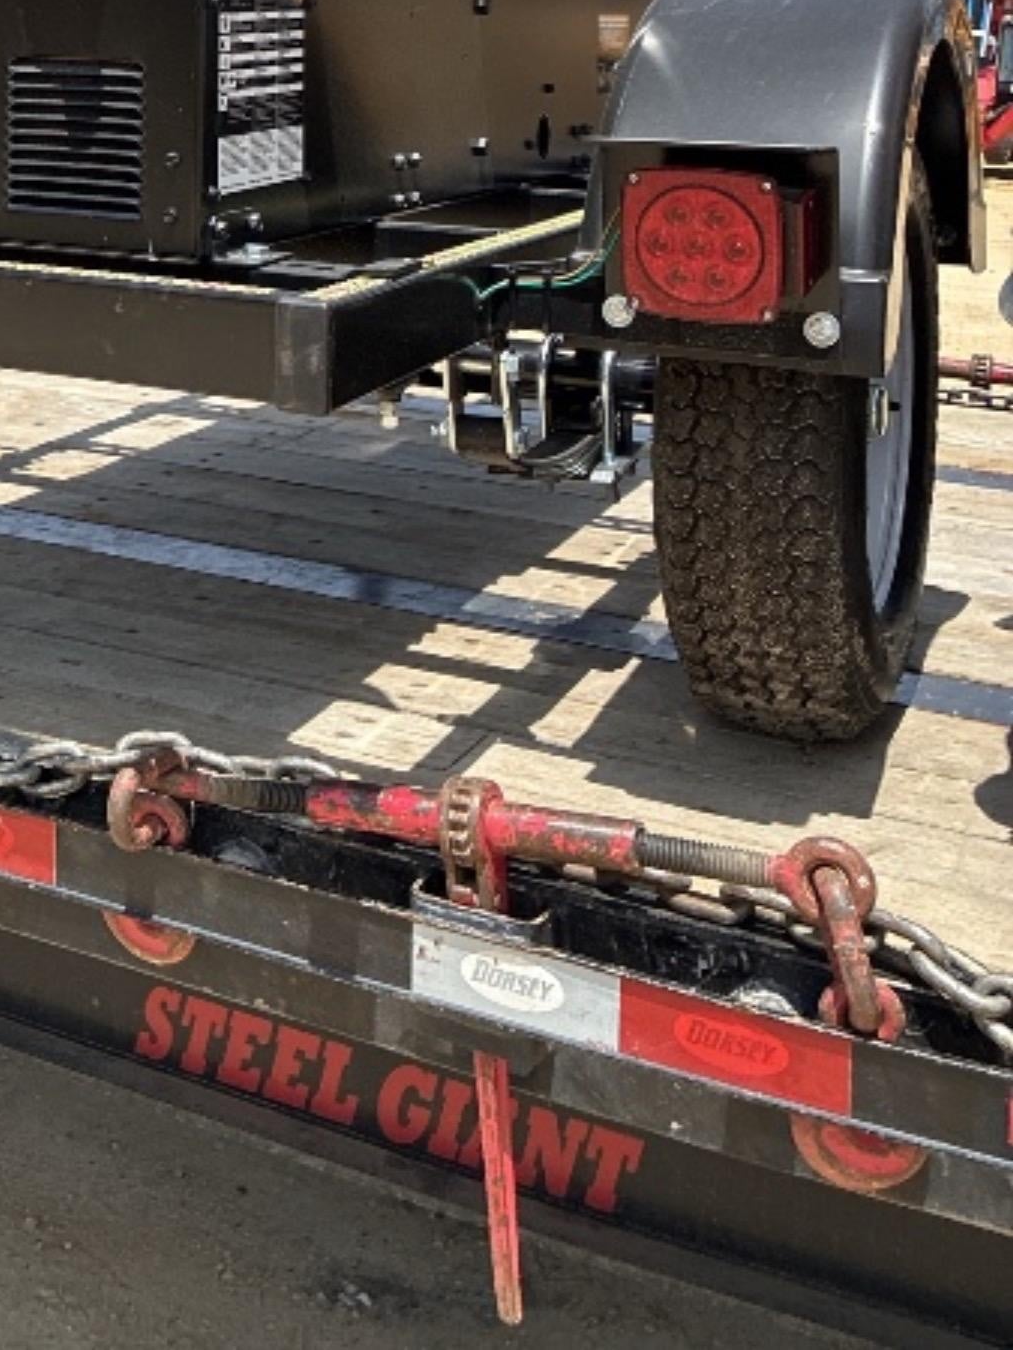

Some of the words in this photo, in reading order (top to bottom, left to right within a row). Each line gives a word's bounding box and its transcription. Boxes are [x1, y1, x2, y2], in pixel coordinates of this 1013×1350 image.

[472, 958, 555, 1003] DORSEY
[135, 985, 359, 1126] STEEL
[688, 1019, 778, 1065] DORSEY
